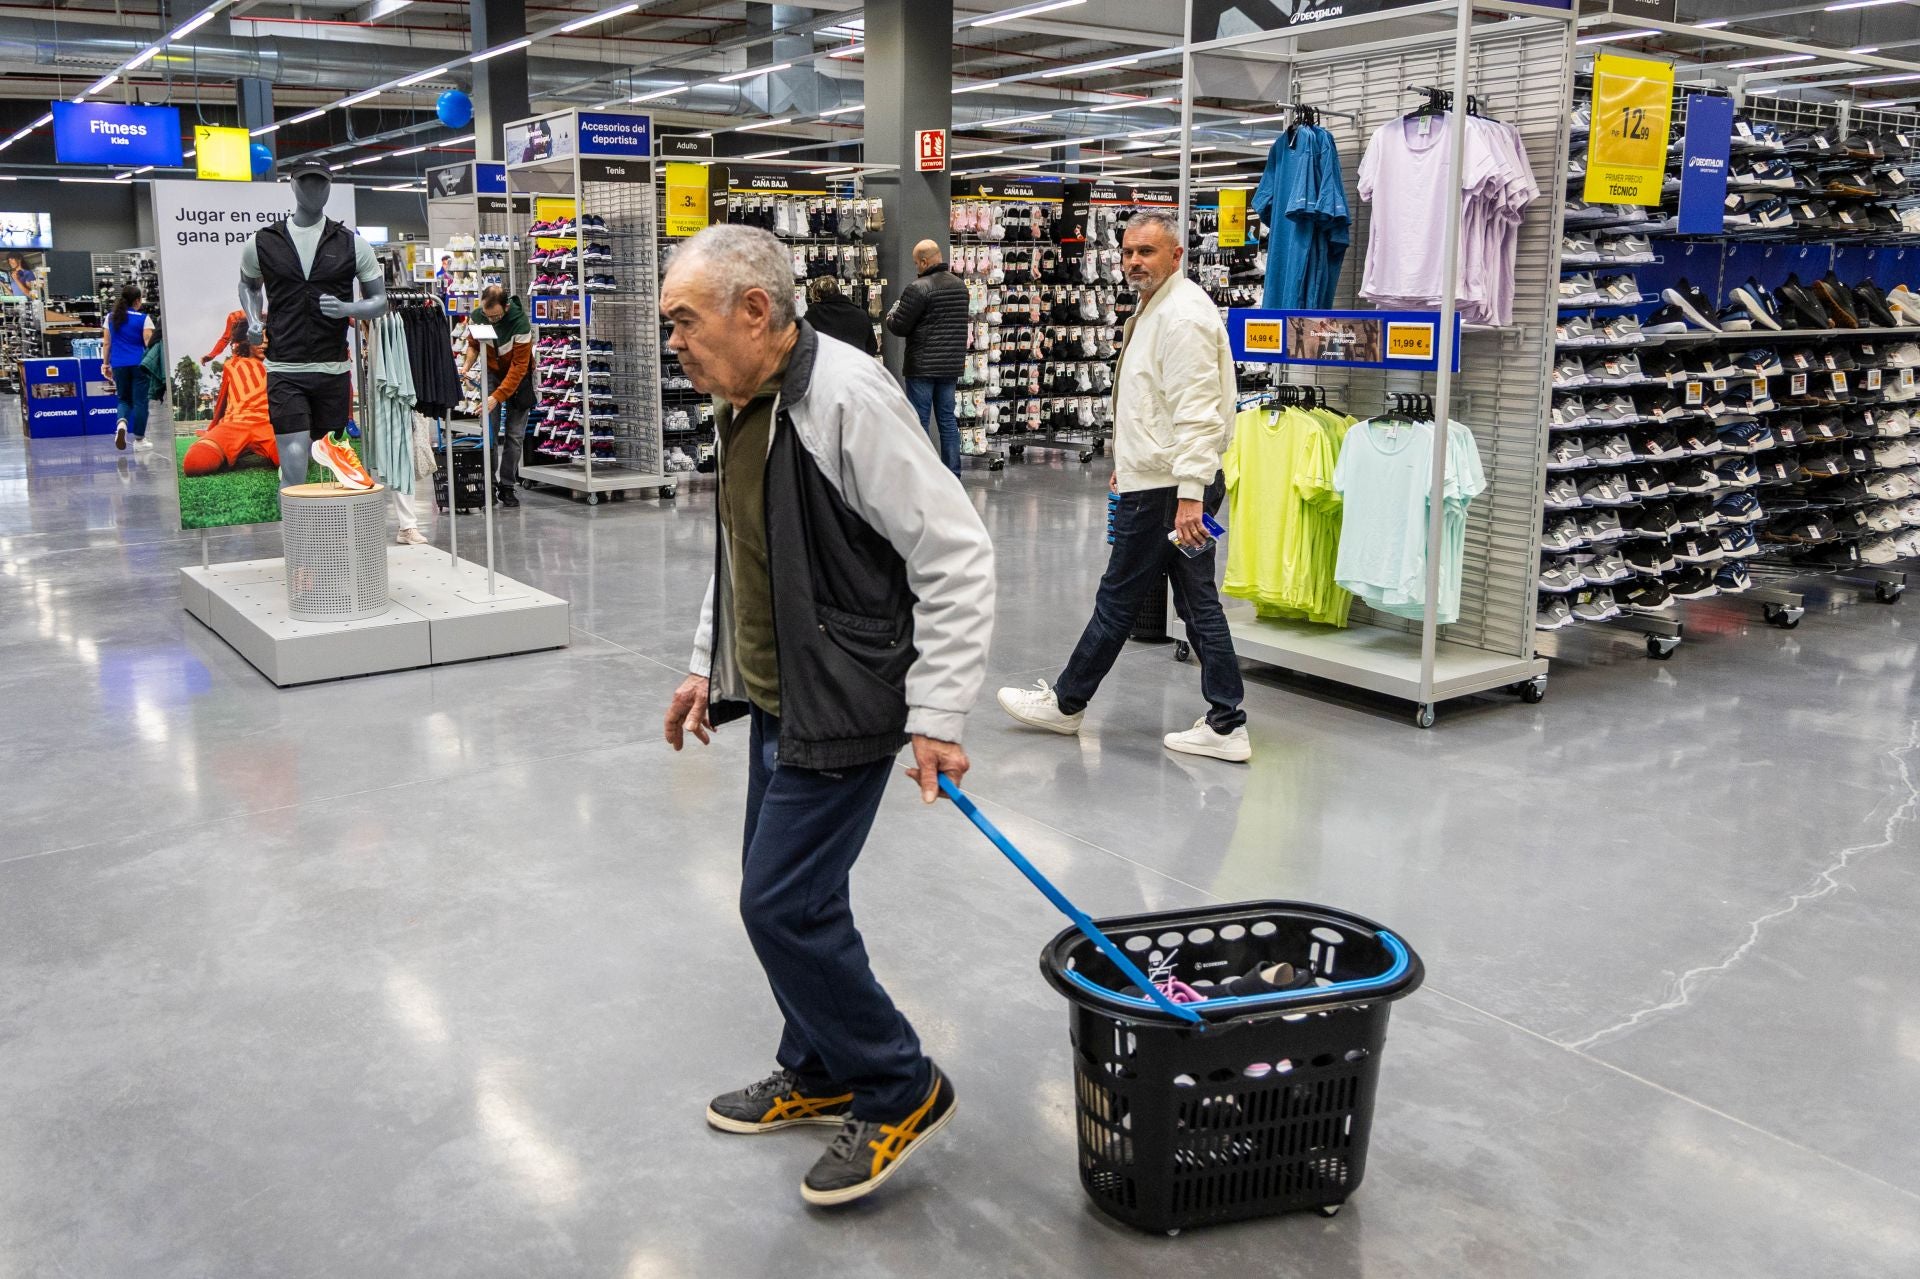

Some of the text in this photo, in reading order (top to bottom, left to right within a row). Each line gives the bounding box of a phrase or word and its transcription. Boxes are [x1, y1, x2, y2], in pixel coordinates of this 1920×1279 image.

[1300, 6, 1342, 21] DECATHLON
[90, 120, 147, 136] Fitness
[581, 121, 646, 133] Accesorios del
[111, 137, 129, 145] Kids
[592, 135, 638, 146] deportista
[676, 142, 698, 150] Adulto
[1696, 158, 1723, 167] DECATHLON
[605, 166, 625, 175] Tenis
[752, 178, 789, 188] CAÑA BAJA
[1605, 173, 1643, 183] PRIMER PRECIO
[1004, 186, 1019, 196] CAÑA
[1020, 188, 1034, 197] BAJA
[1090, 191, 1117, 200] AÑA MEDIA
[1609, 185, 1638, 197] TÉCNICO
[1143, 193, 1173, 202] CAÑA MEDIA
[175, 207, 225, 225] Jugar
[231, 210, 251, 223] en
[177, 230, 220, 246] gana
[1249, 334, 1274, 343] 14,99 €
[1393, 339, 1423, 349] 11,99 €
[43, 410, 77, 418] DECATHLON
